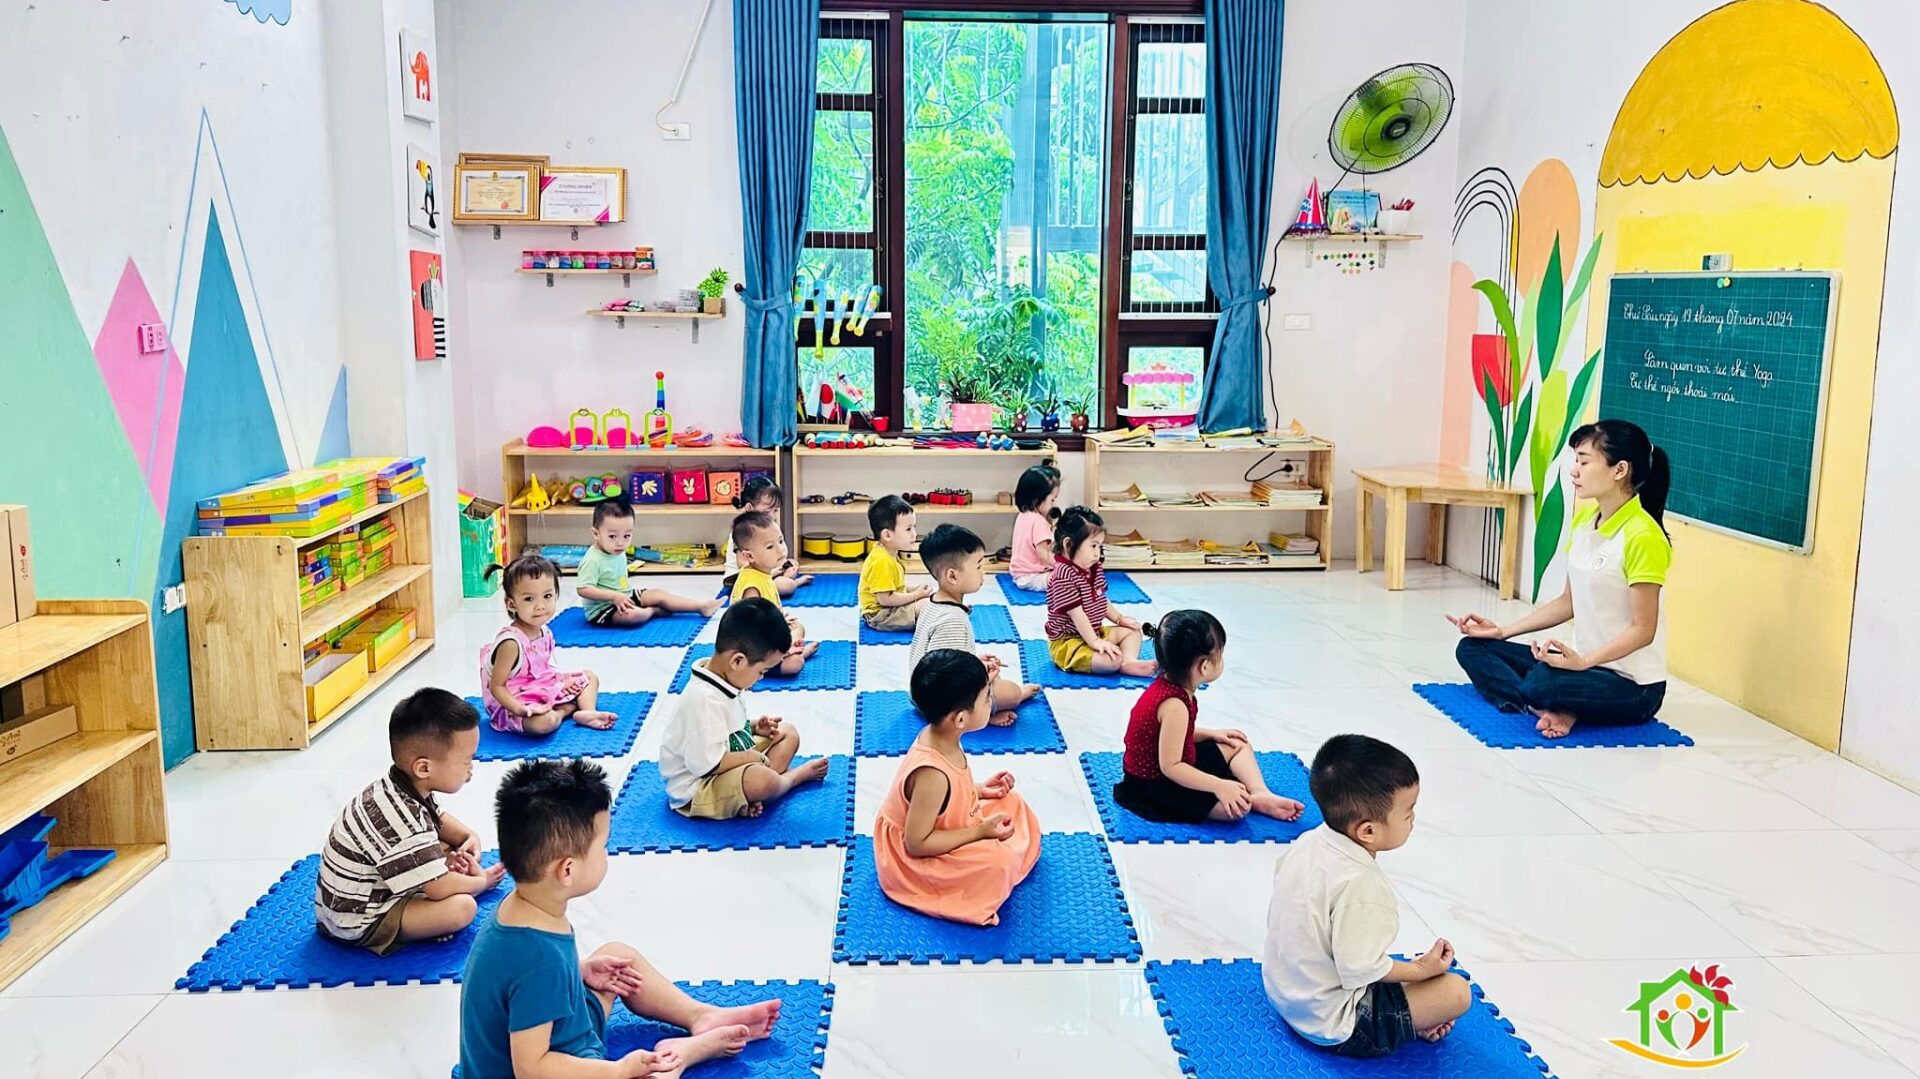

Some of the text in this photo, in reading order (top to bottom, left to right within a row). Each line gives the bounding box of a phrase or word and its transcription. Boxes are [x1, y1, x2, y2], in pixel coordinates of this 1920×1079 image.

[1681, 308, 1692, 323] 19
[1694, 304, 1724, 334] tháng
[1726, 308, 1739, 325] 07
[1766, 310, 1793, 327] 2024
[1753, 363, 1773, 389] Yoga
